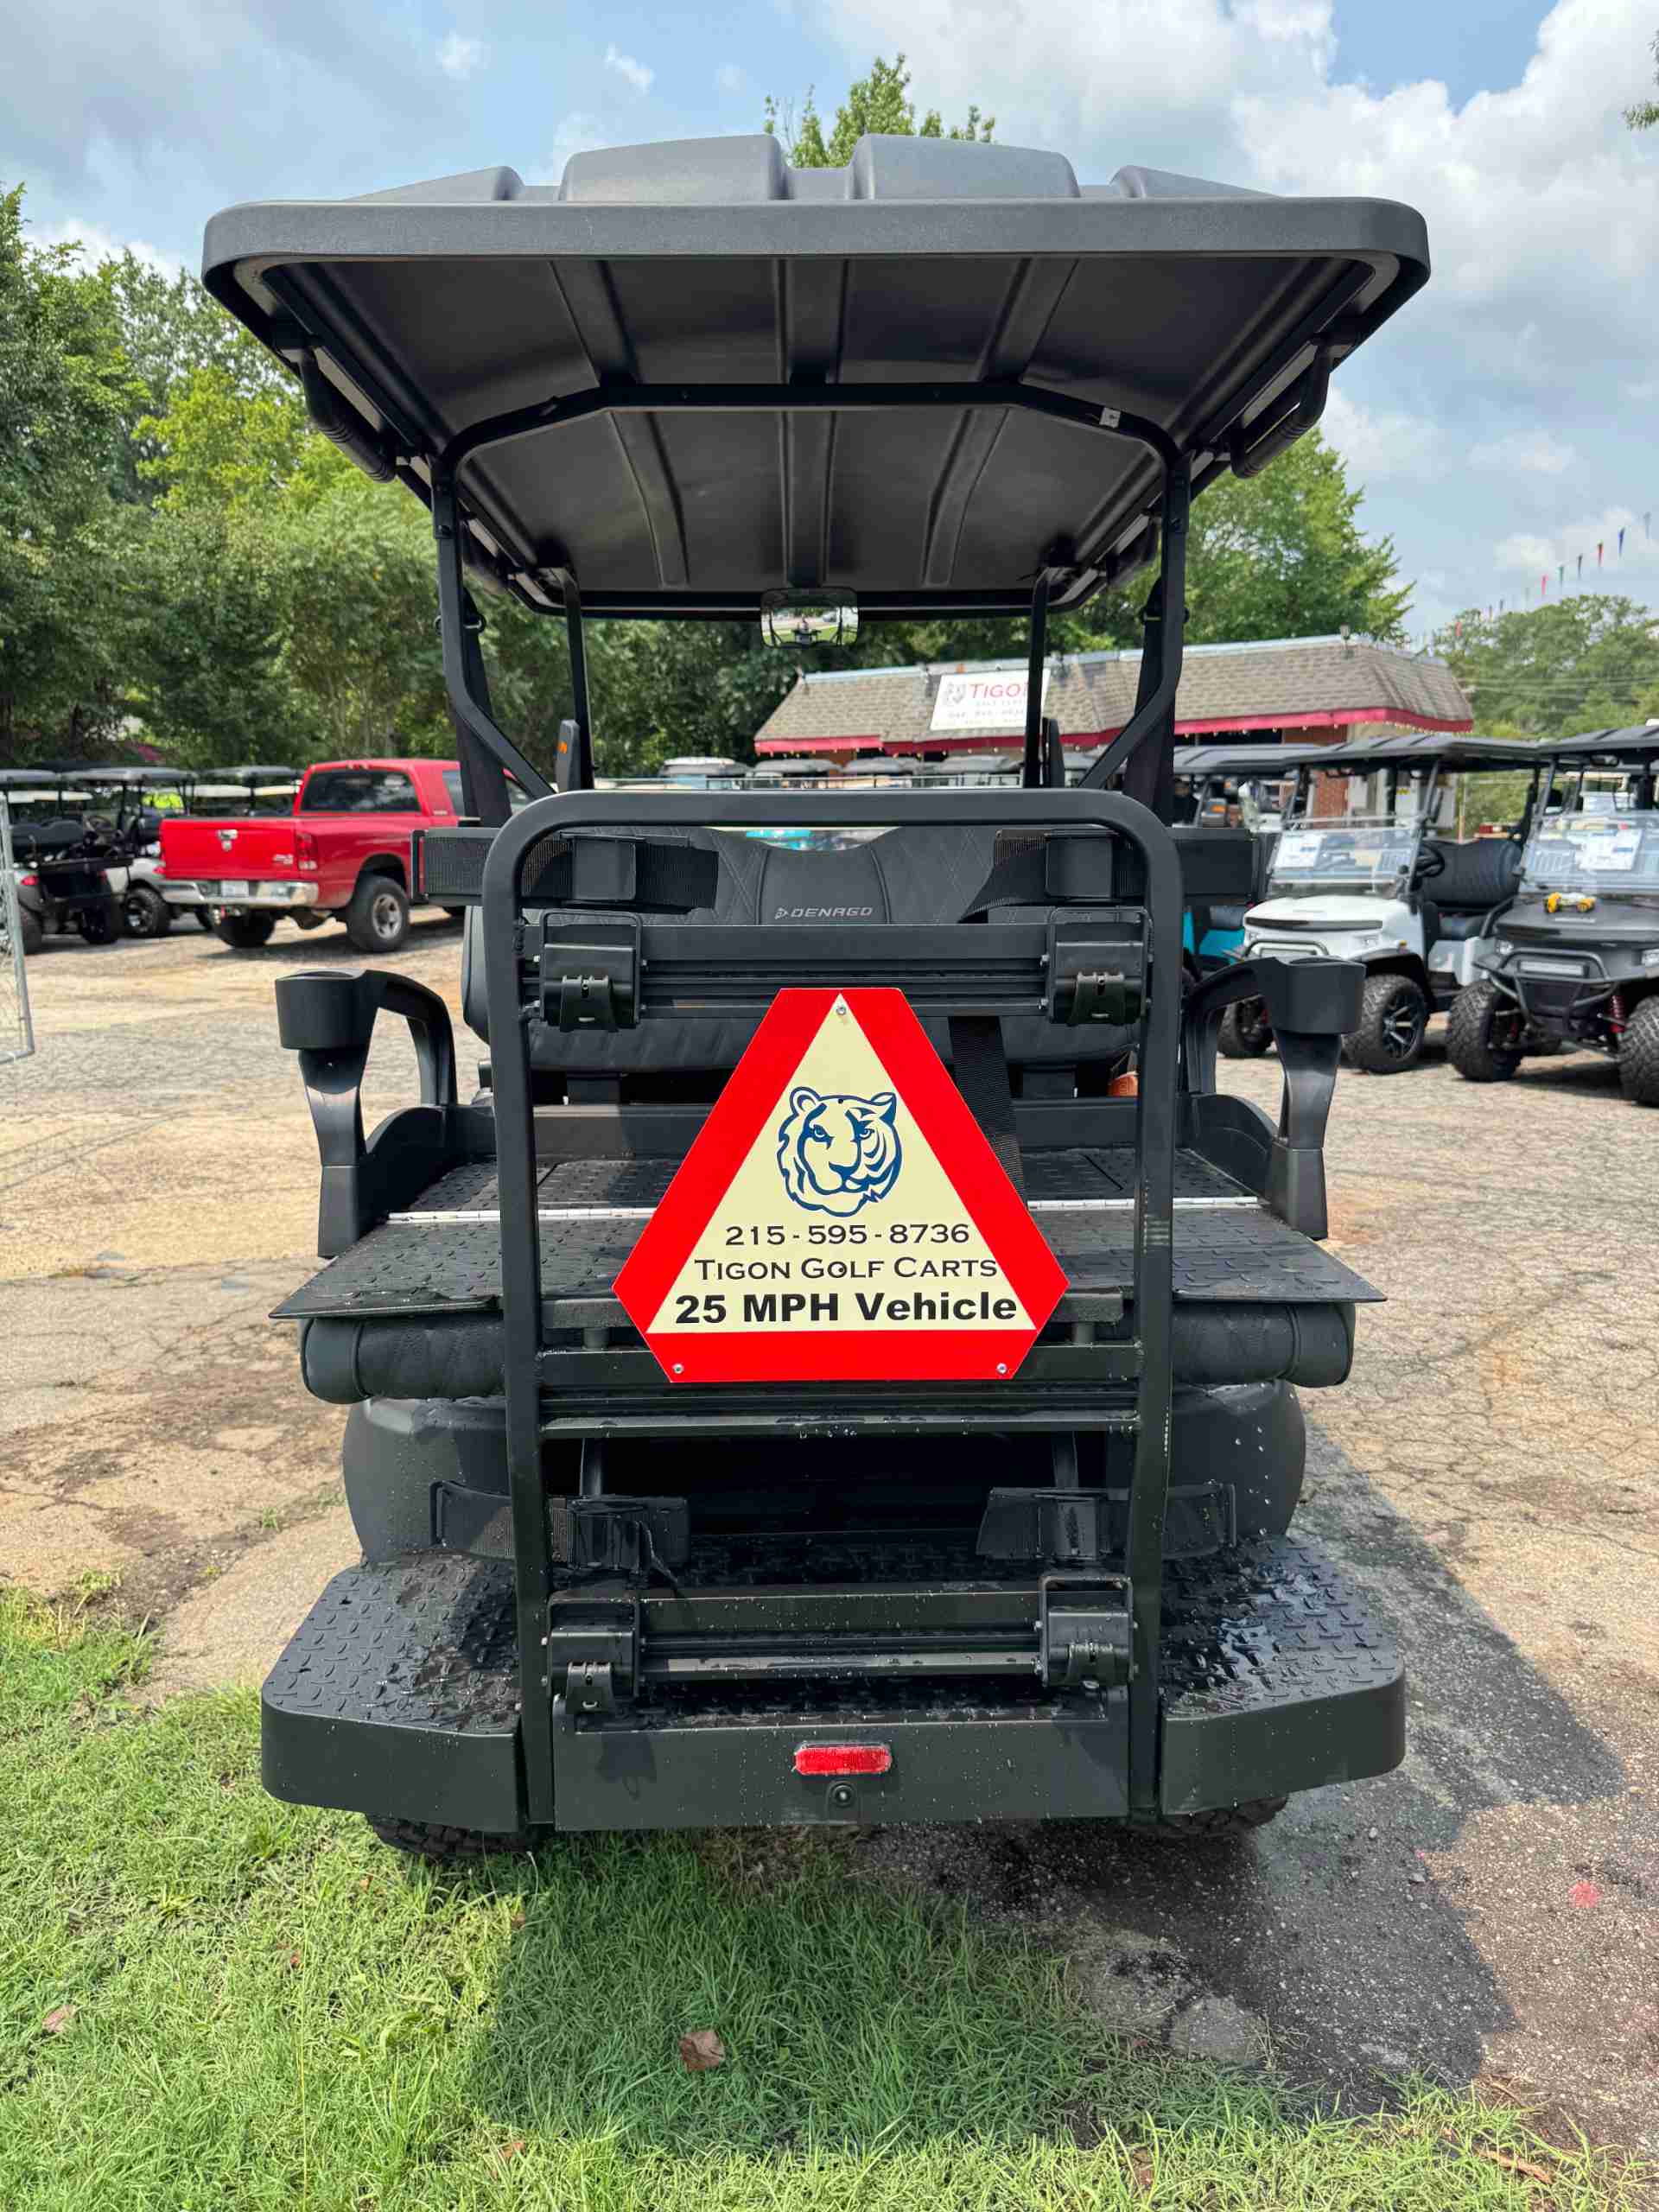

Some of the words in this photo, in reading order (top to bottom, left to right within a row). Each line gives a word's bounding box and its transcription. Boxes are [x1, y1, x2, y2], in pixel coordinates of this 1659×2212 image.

[791, 906, 873, 918] DENAGO
[694, 1259, 791, 1281] TIGON
[801, 1257, 885, 1279] GOLF
[893, 1256, 997, 1278] CARTS
[675, 1294, 727, 1325] 25
[743, 1292, 838, 1323] MPH
[855, 1291, 1017, 1321] Vehicle
